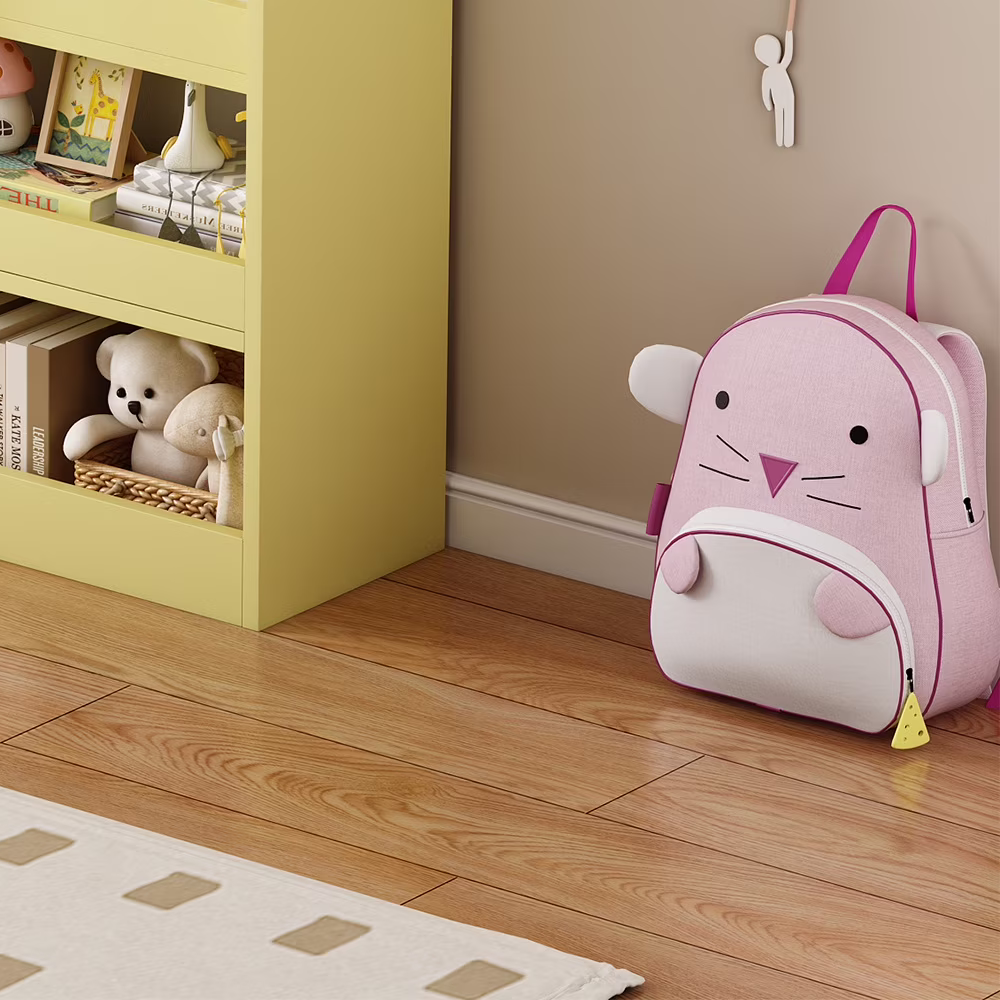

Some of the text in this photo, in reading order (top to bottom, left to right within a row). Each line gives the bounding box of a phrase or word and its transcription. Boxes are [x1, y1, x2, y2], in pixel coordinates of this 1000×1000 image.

[0, 186, 57, 213] THE
[11, 414, 21, 444] KATE
[32, 426, 44, 476] LEADERSHIP
